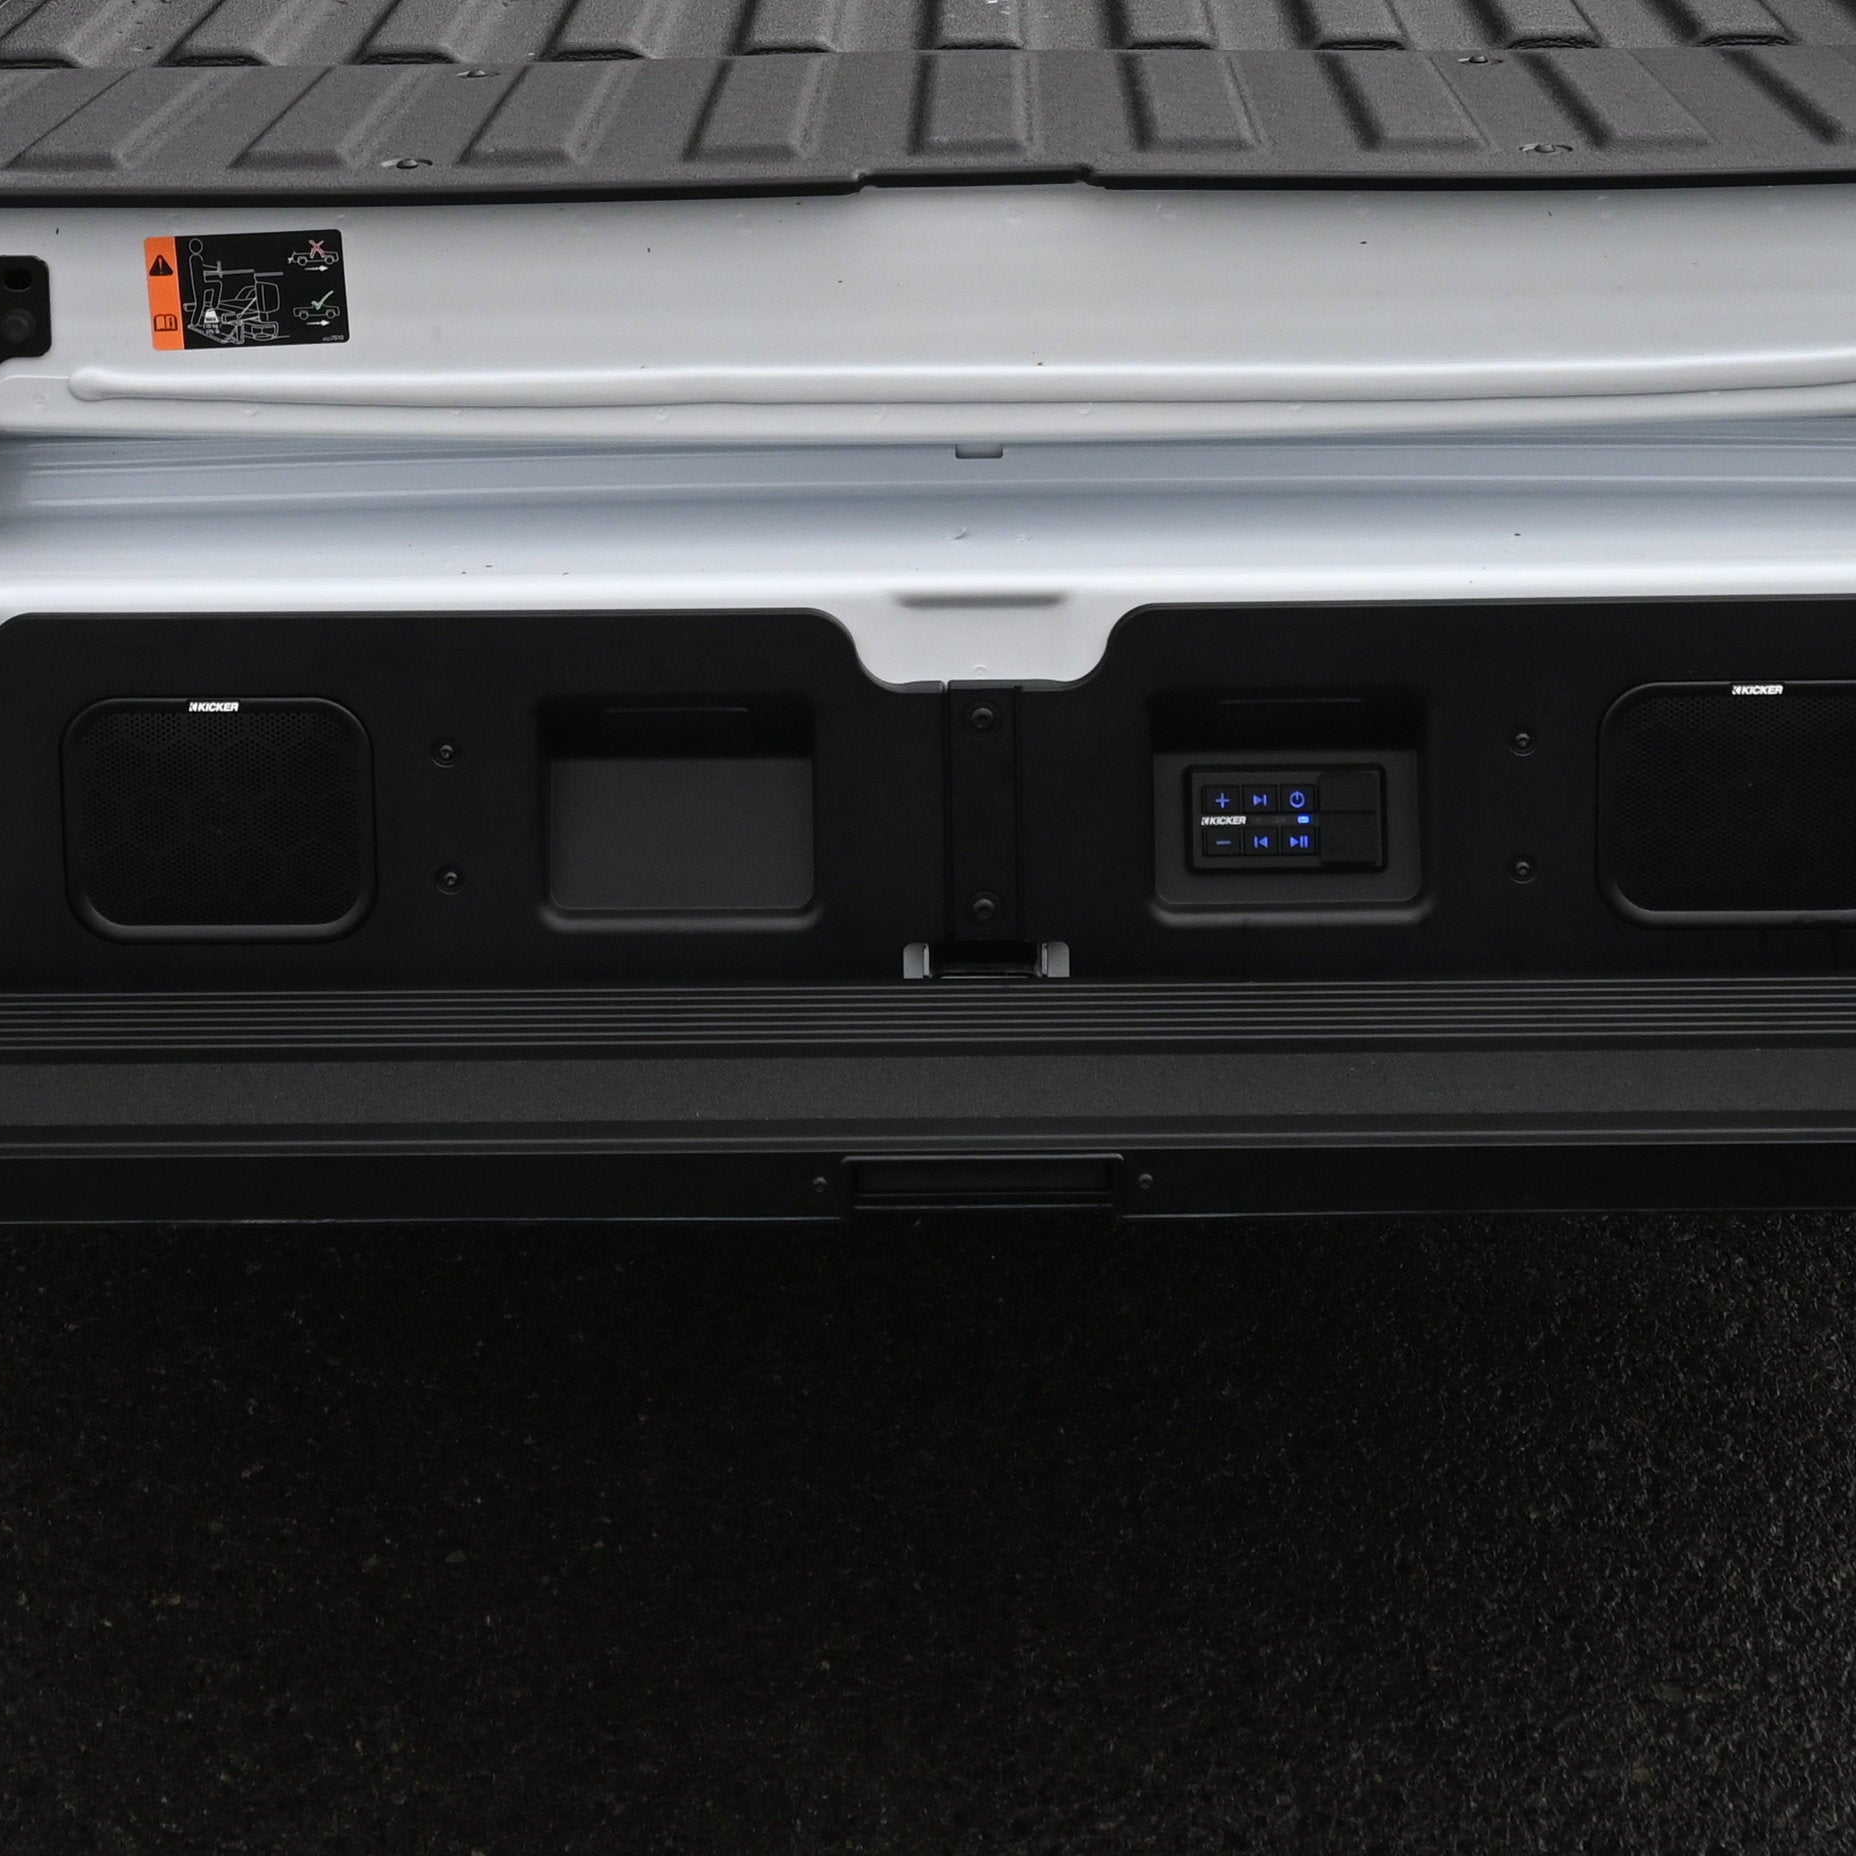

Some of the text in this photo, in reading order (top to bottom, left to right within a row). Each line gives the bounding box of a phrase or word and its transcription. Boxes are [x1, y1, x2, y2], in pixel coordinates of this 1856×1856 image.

[1741, 684, 1784, 695] KICKER
[197, 701, 240, 712] KICKER
[1209, 815, 1247, 825] KICKER
